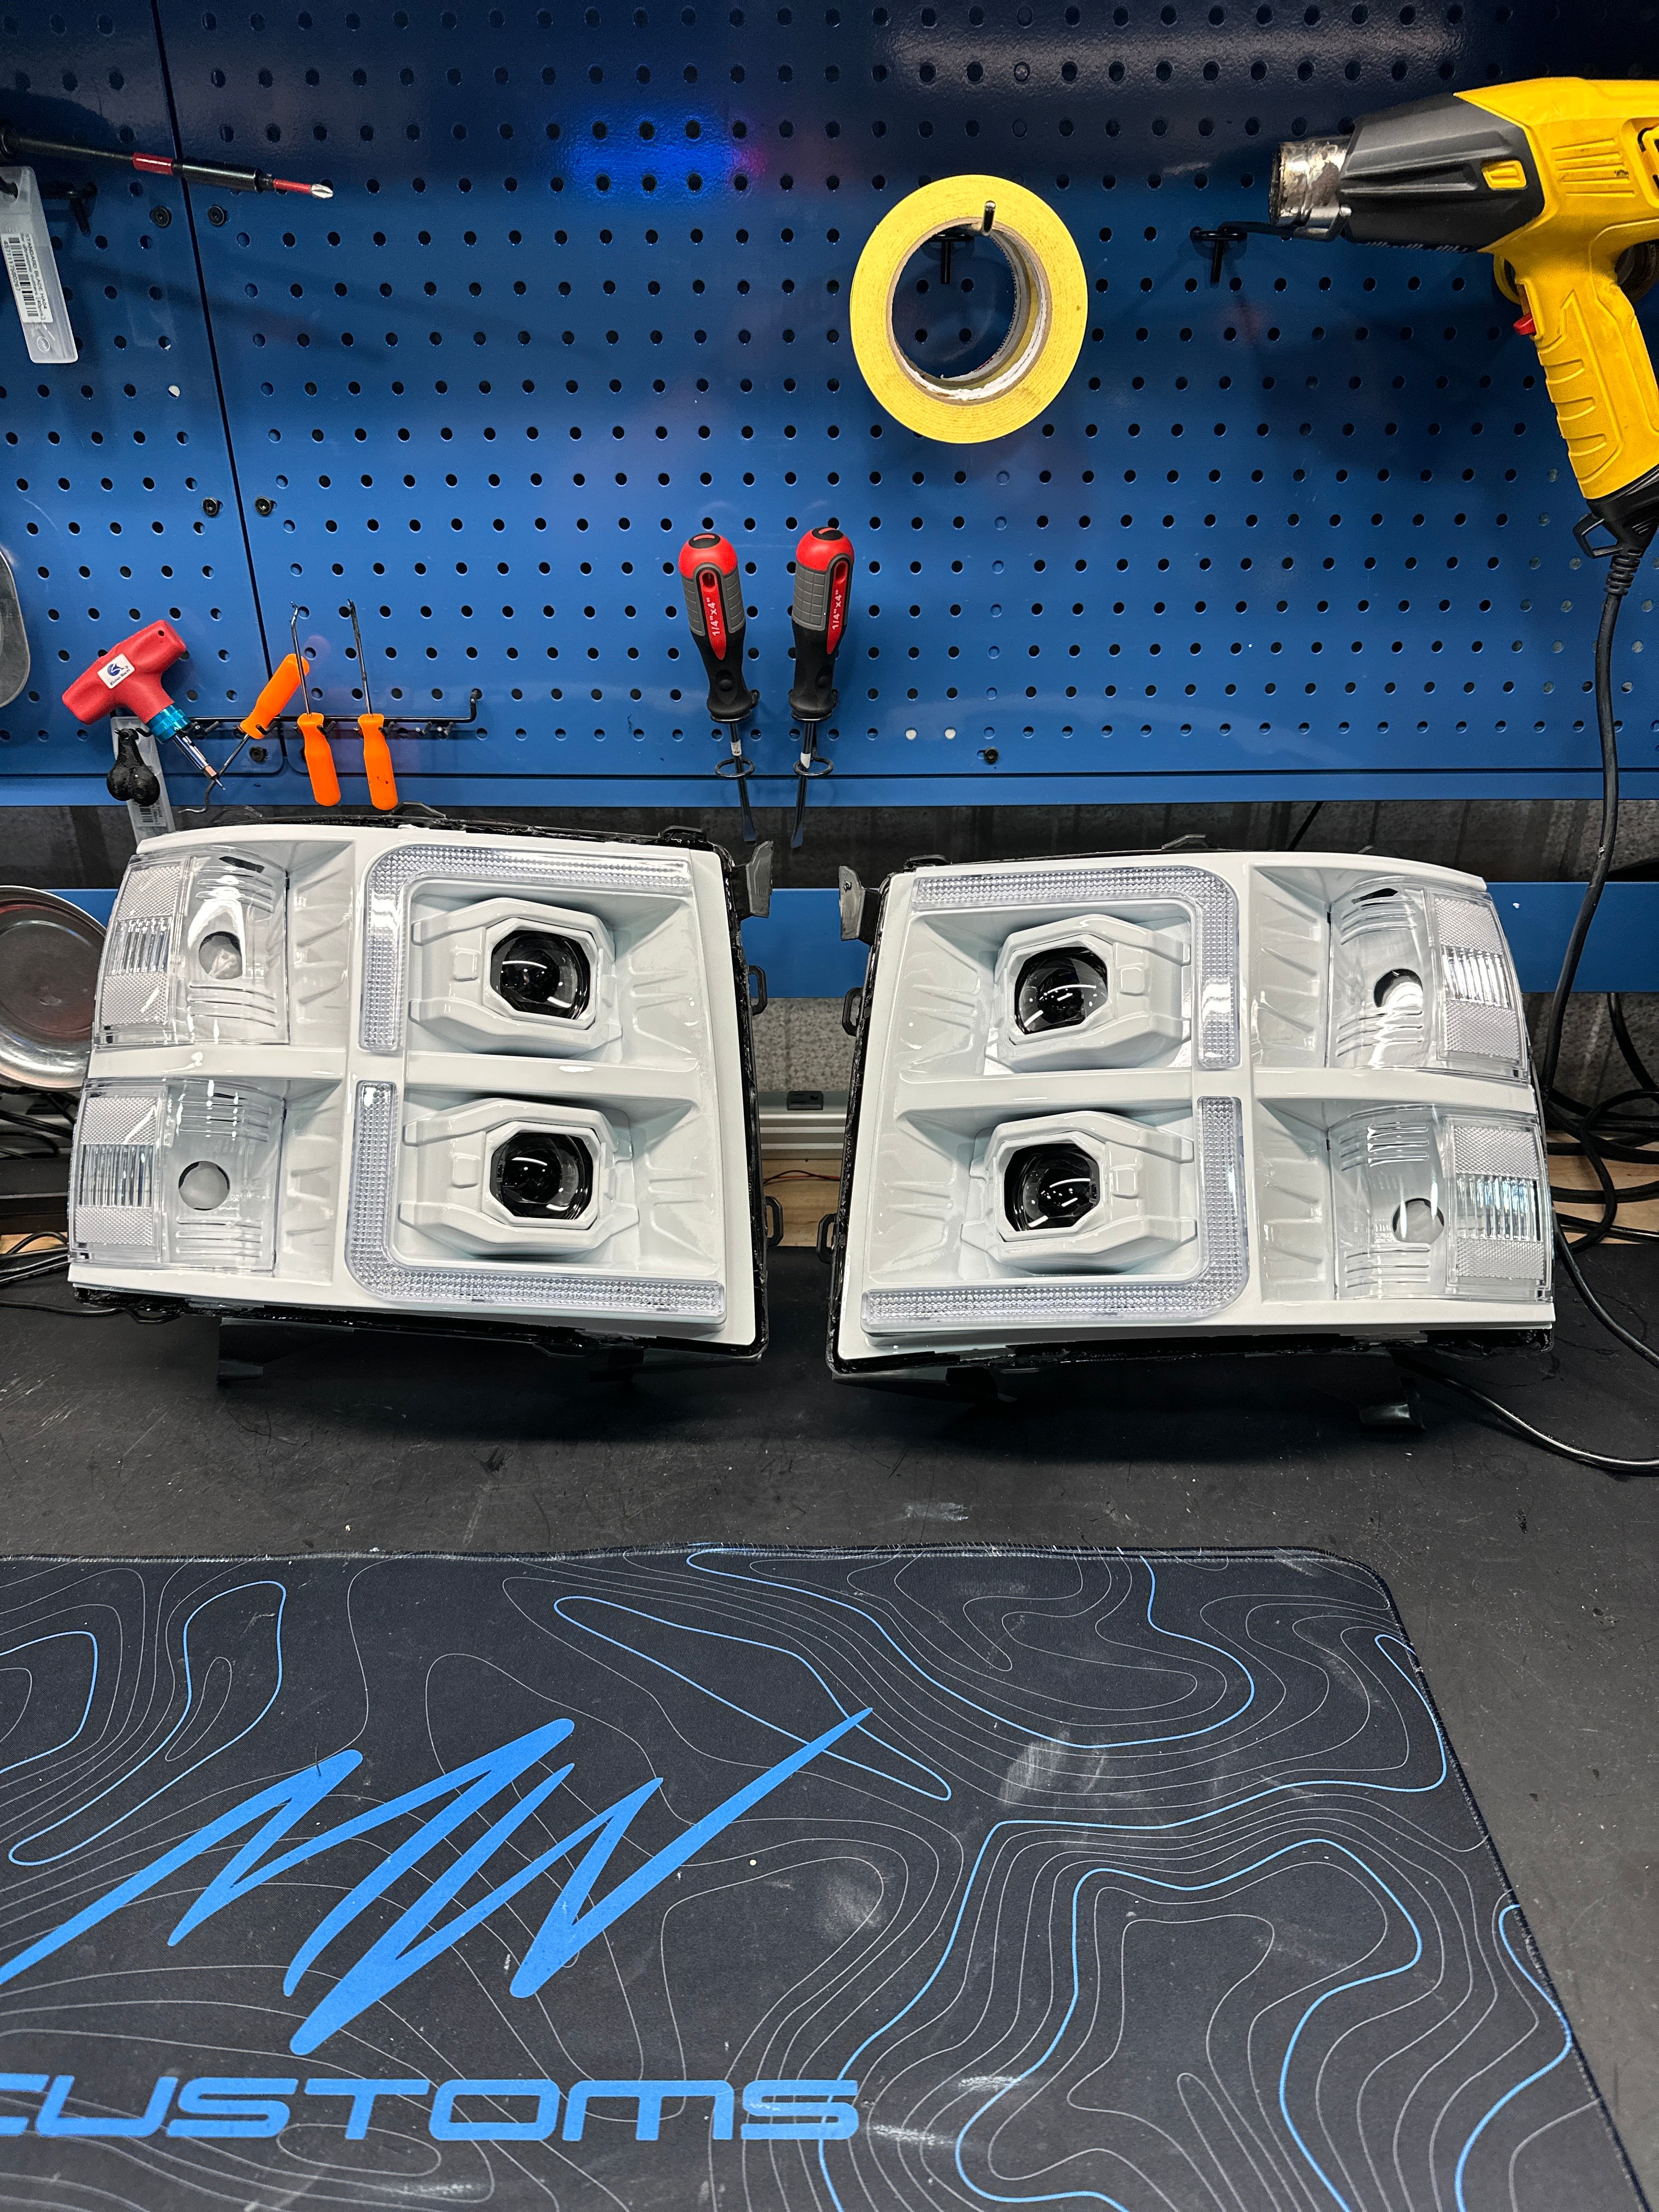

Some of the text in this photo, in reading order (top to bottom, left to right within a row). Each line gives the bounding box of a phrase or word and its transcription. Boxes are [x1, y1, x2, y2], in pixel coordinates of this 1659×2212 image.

[22, 243, 32, 273] ultrasonic
[25, 233, 37, 269] STANDARD
[35, 270, 43, 291] BLADE
[706, 597, 720, 636] 1/4"x4"
[832, 589, 842, 630] 1/4"x4"
